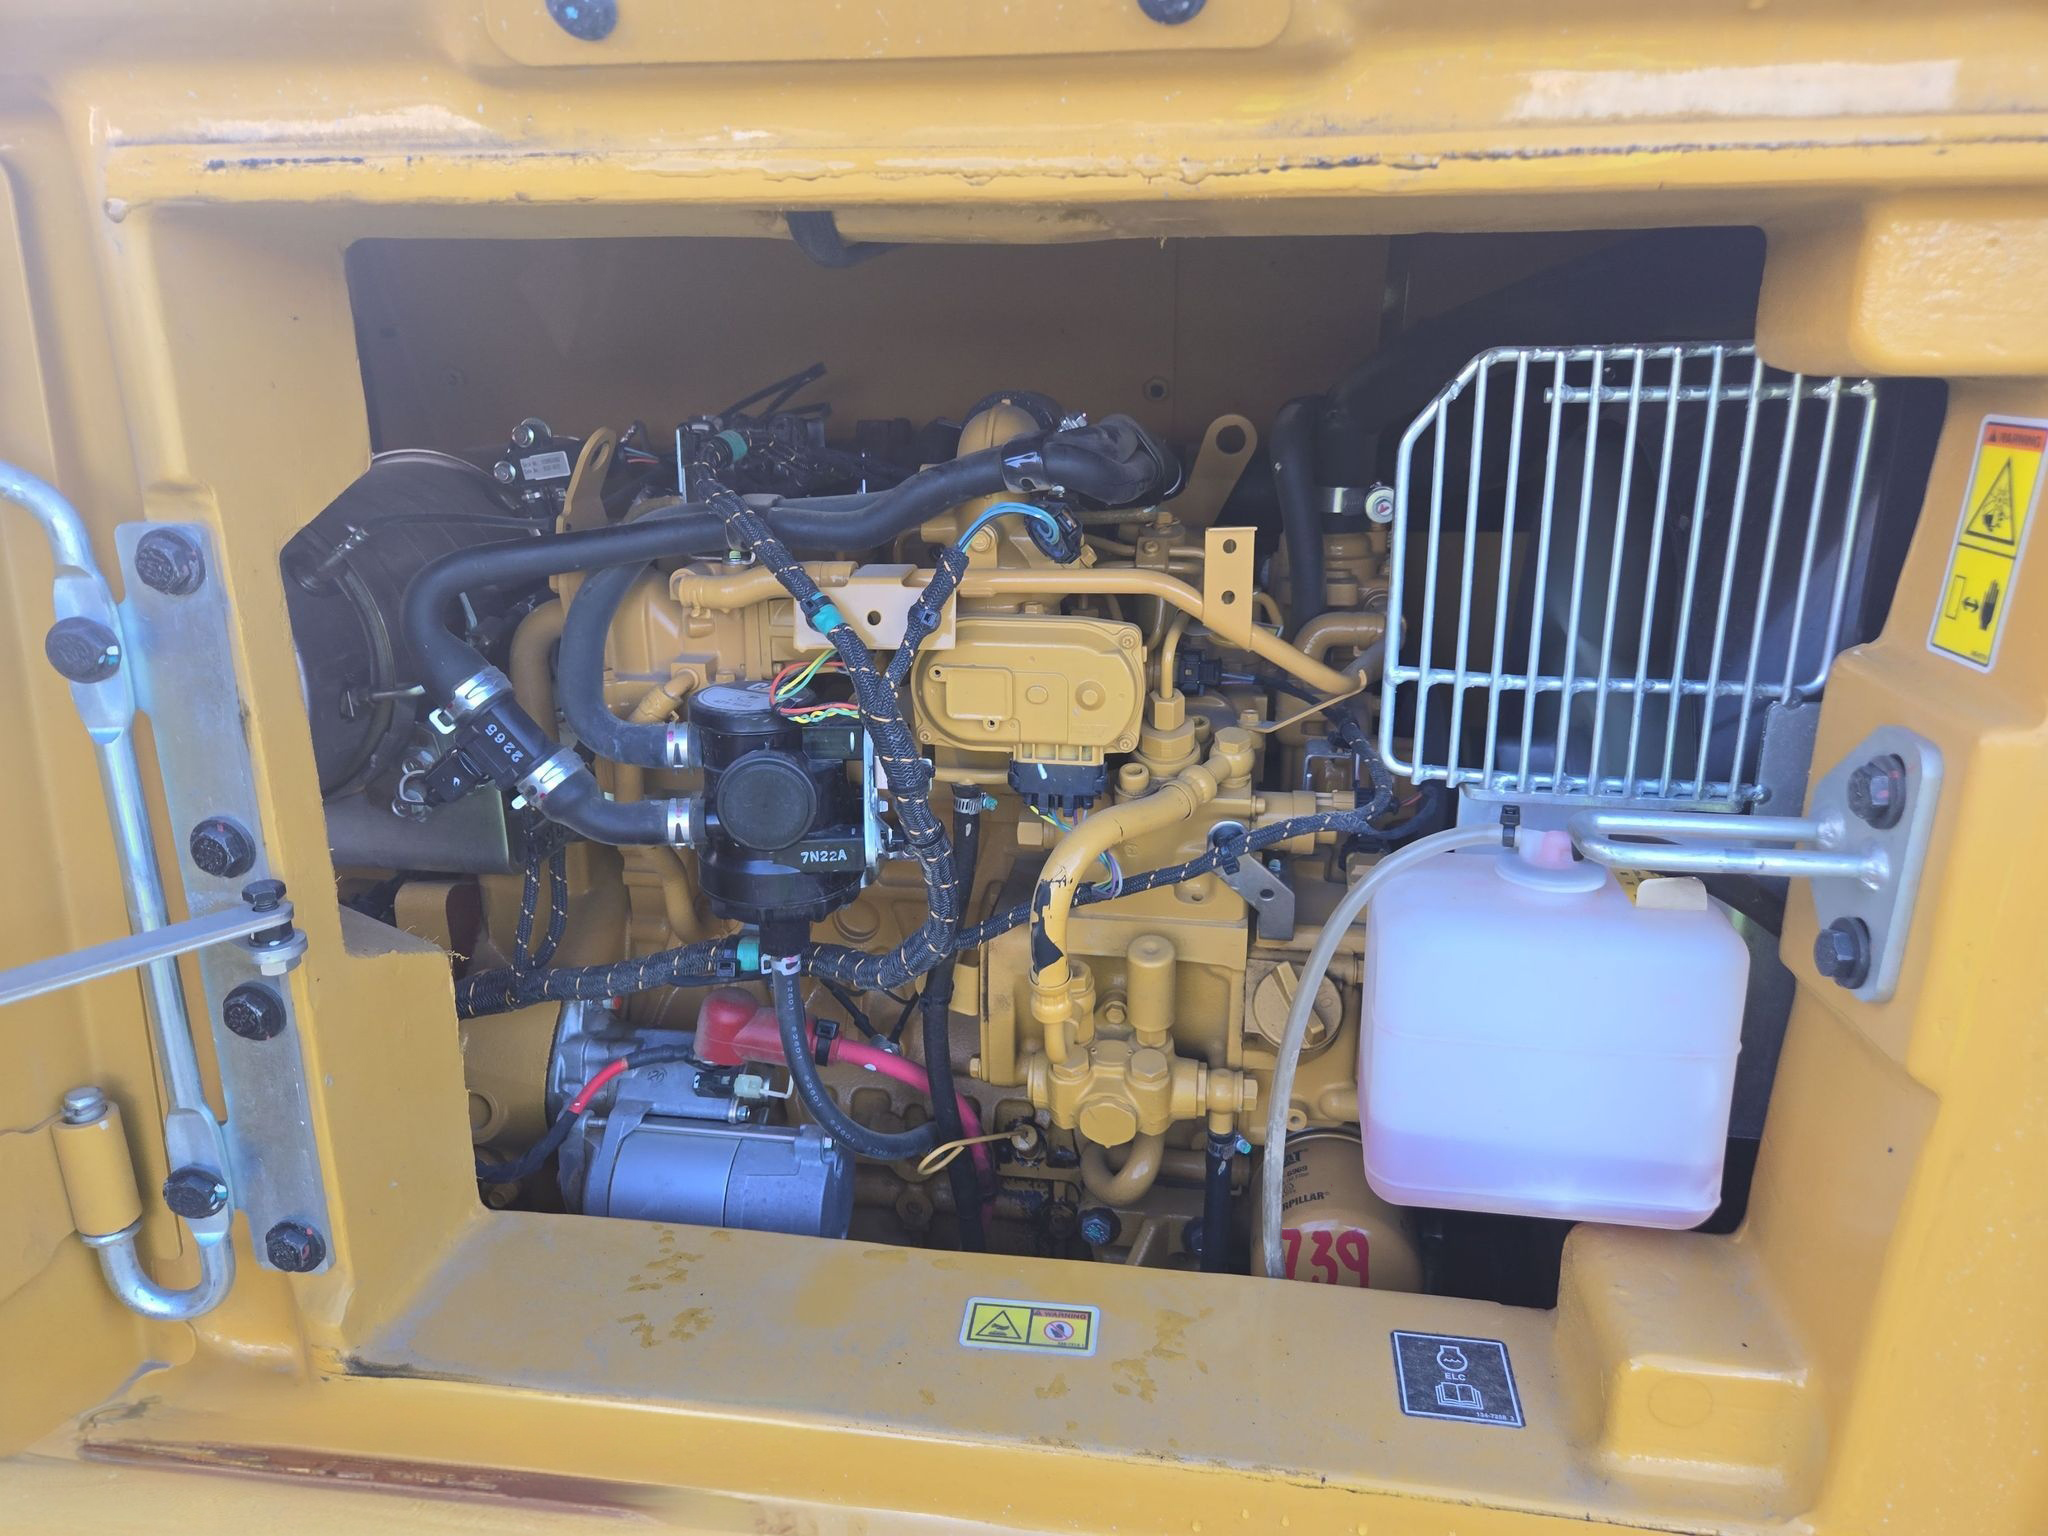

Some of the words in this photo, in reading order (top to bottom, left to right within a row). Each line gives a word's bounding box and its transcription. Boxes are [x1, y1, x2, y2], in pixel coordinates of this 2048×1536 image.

[485, 724, 524, 763] 2265
[800, 849, 848, 864] 7N22A
[1282, 1191, 1325, 1212] RPILLAR
[1282, 1229, 1369, 1288] 739
[1044, 1311, 1087, 1320] WARNING
[1444, 1372, 1467, 1381] ELC
